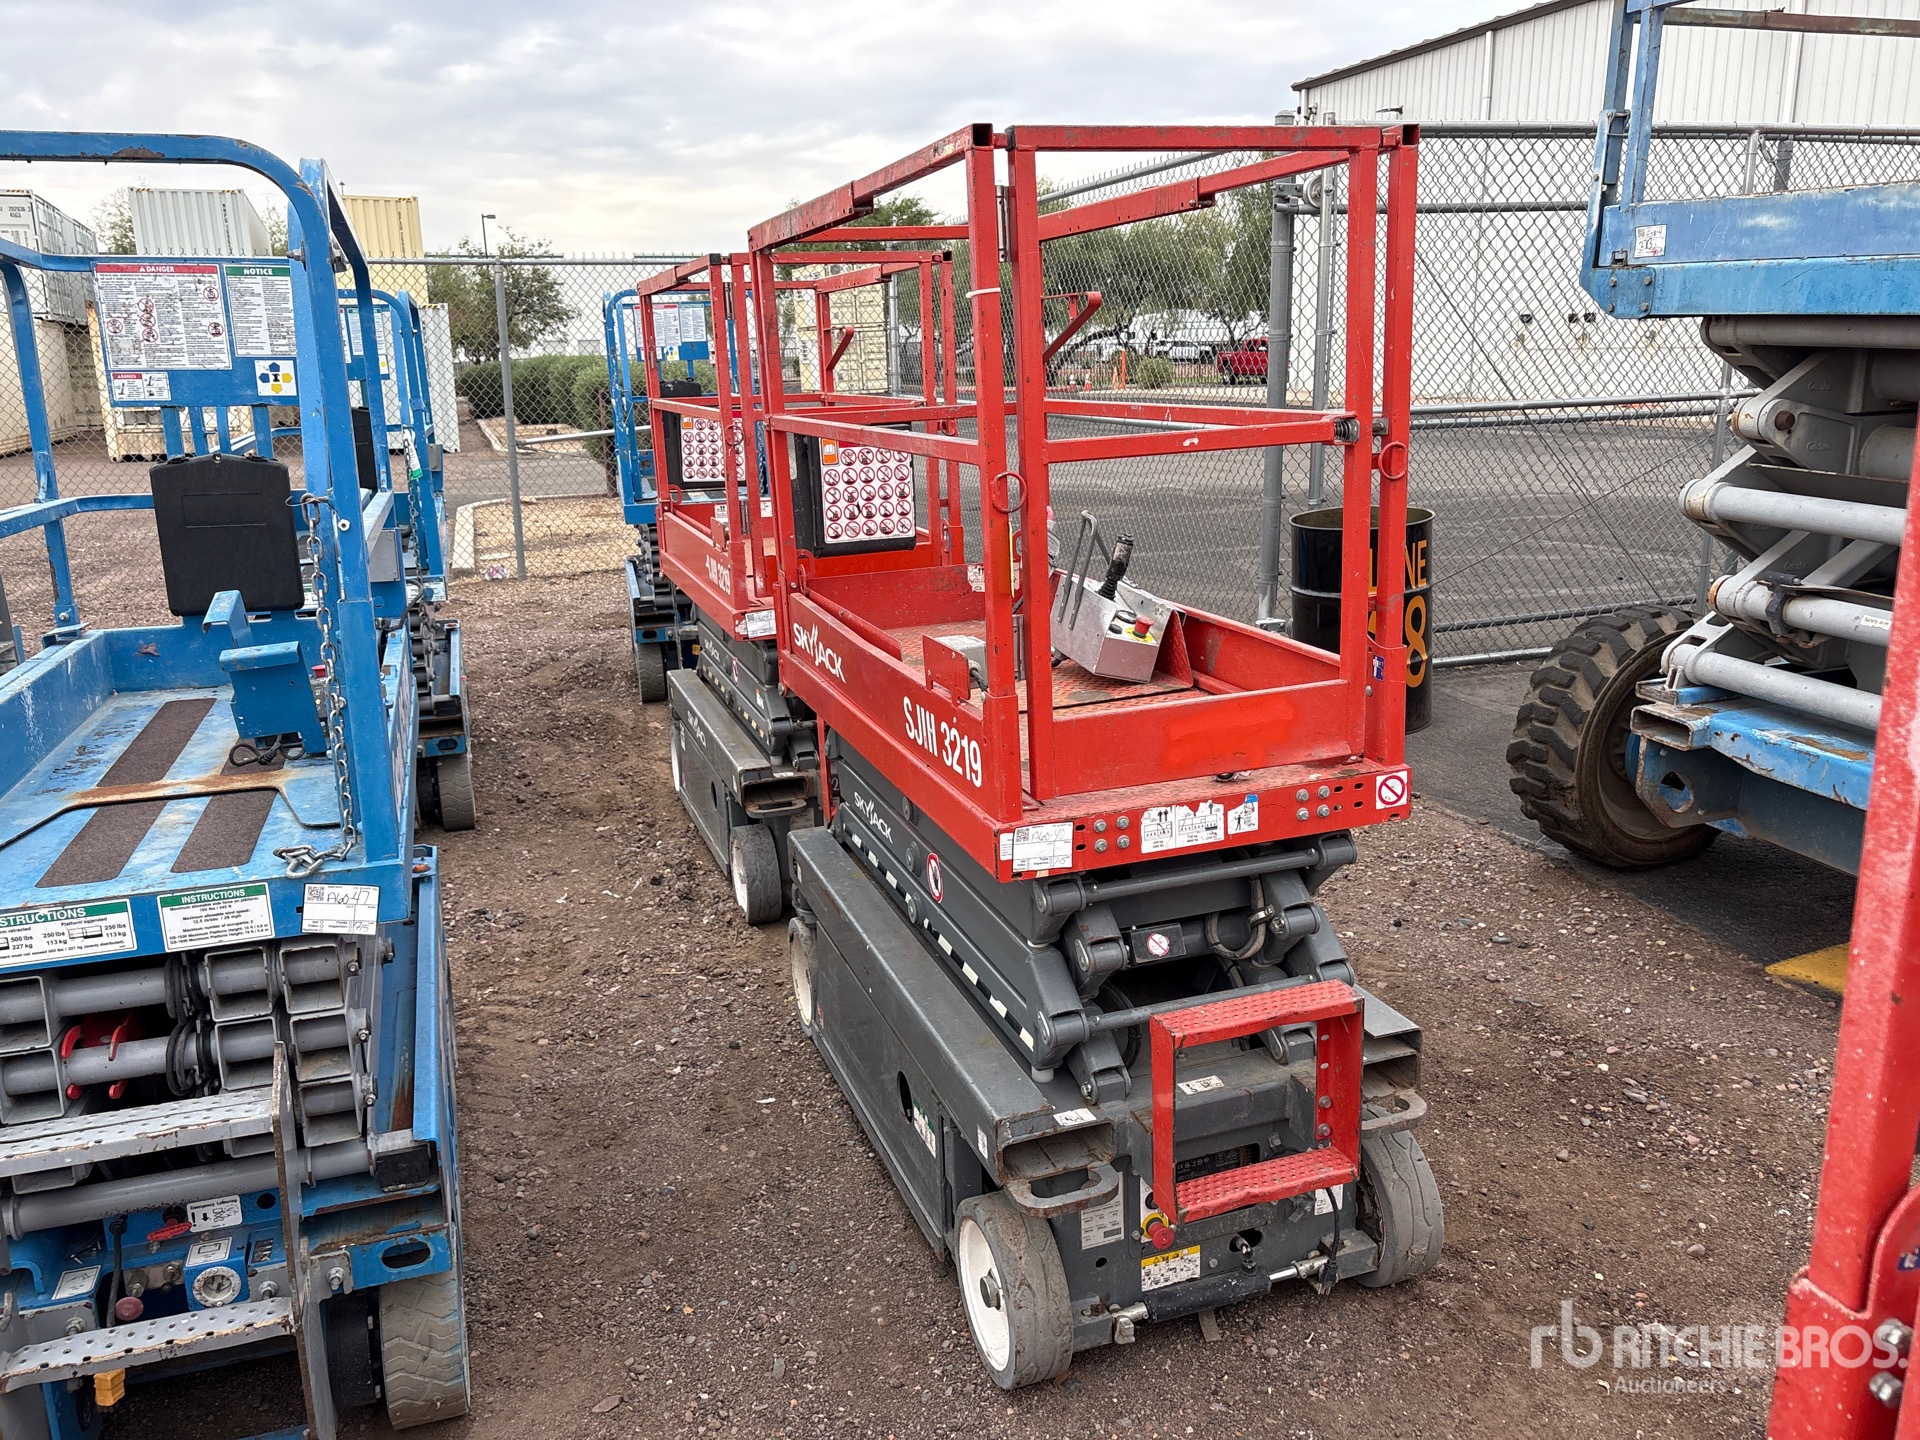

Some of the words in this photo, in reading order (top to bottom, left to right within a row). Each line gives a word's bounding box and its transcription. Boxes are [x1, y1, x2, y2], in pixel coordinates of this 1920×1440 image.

[793, 622, 846, 684] SKYJACK
[940, 721, 982, 788] 3219
[854, 792, 893, 844] SKYJACK
[181, 889, 245, 903] INSTRUCTIONS
